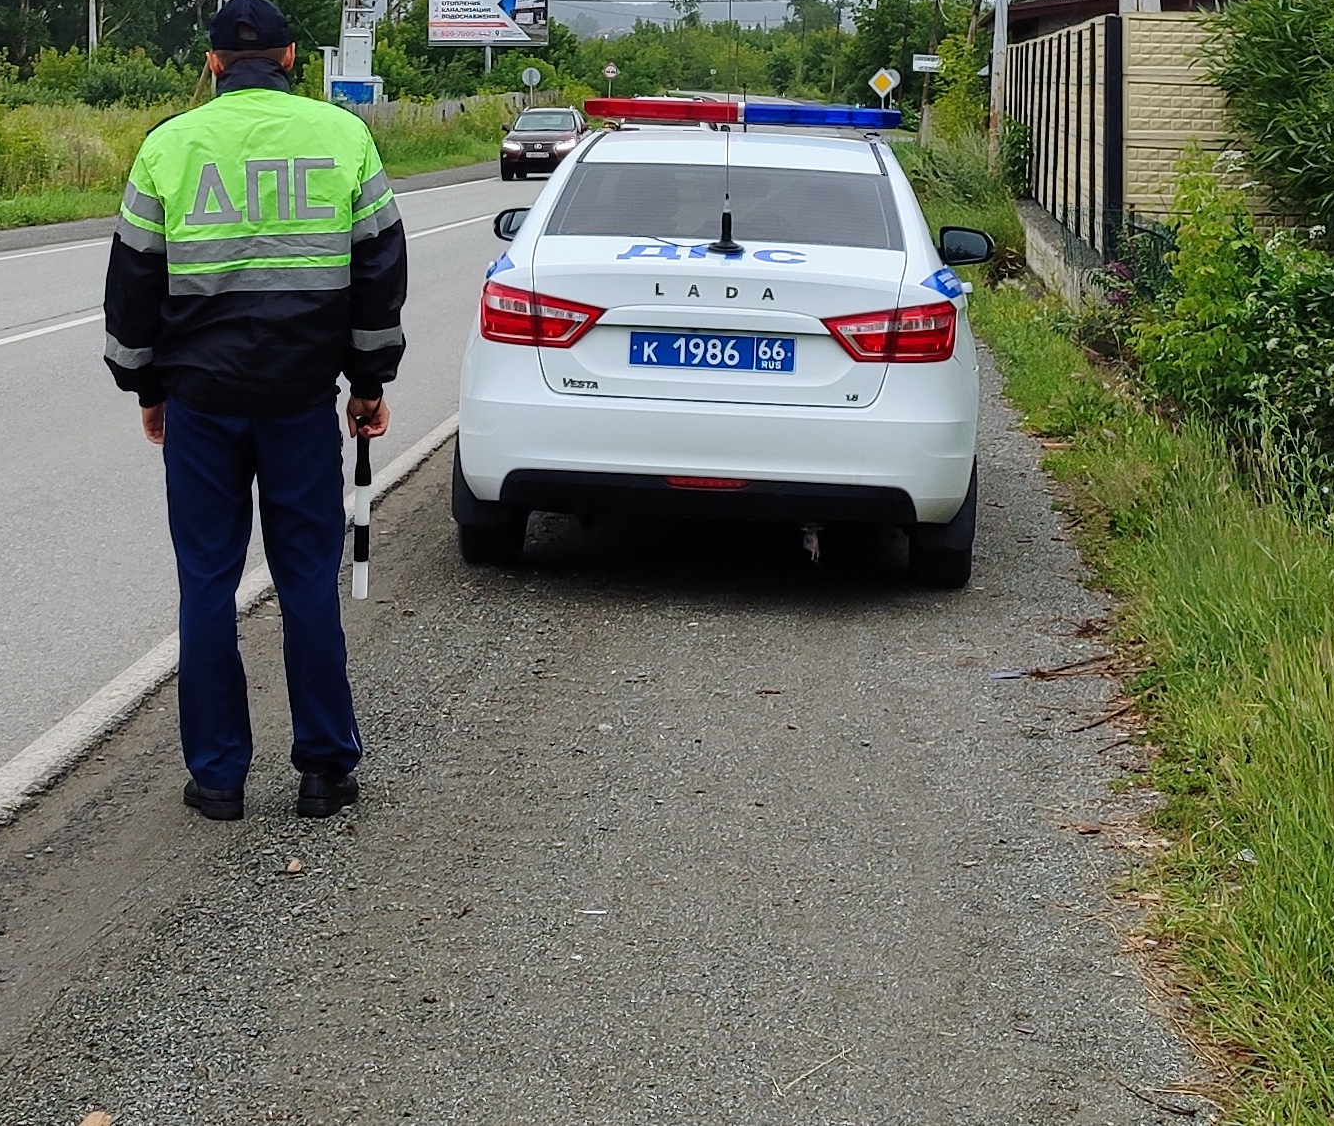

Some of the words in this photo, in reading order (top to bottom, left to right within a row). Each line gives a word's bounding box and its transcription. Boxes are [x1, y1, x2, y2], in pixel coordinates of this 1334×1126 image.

[184, 157, 336, 226] ДПС
[655, 282, 775, 301] LADA
[672, 337, 740, 366] 1986
[758, 340, 786, 361] 66
[761, 360, 782, 370] RUS
